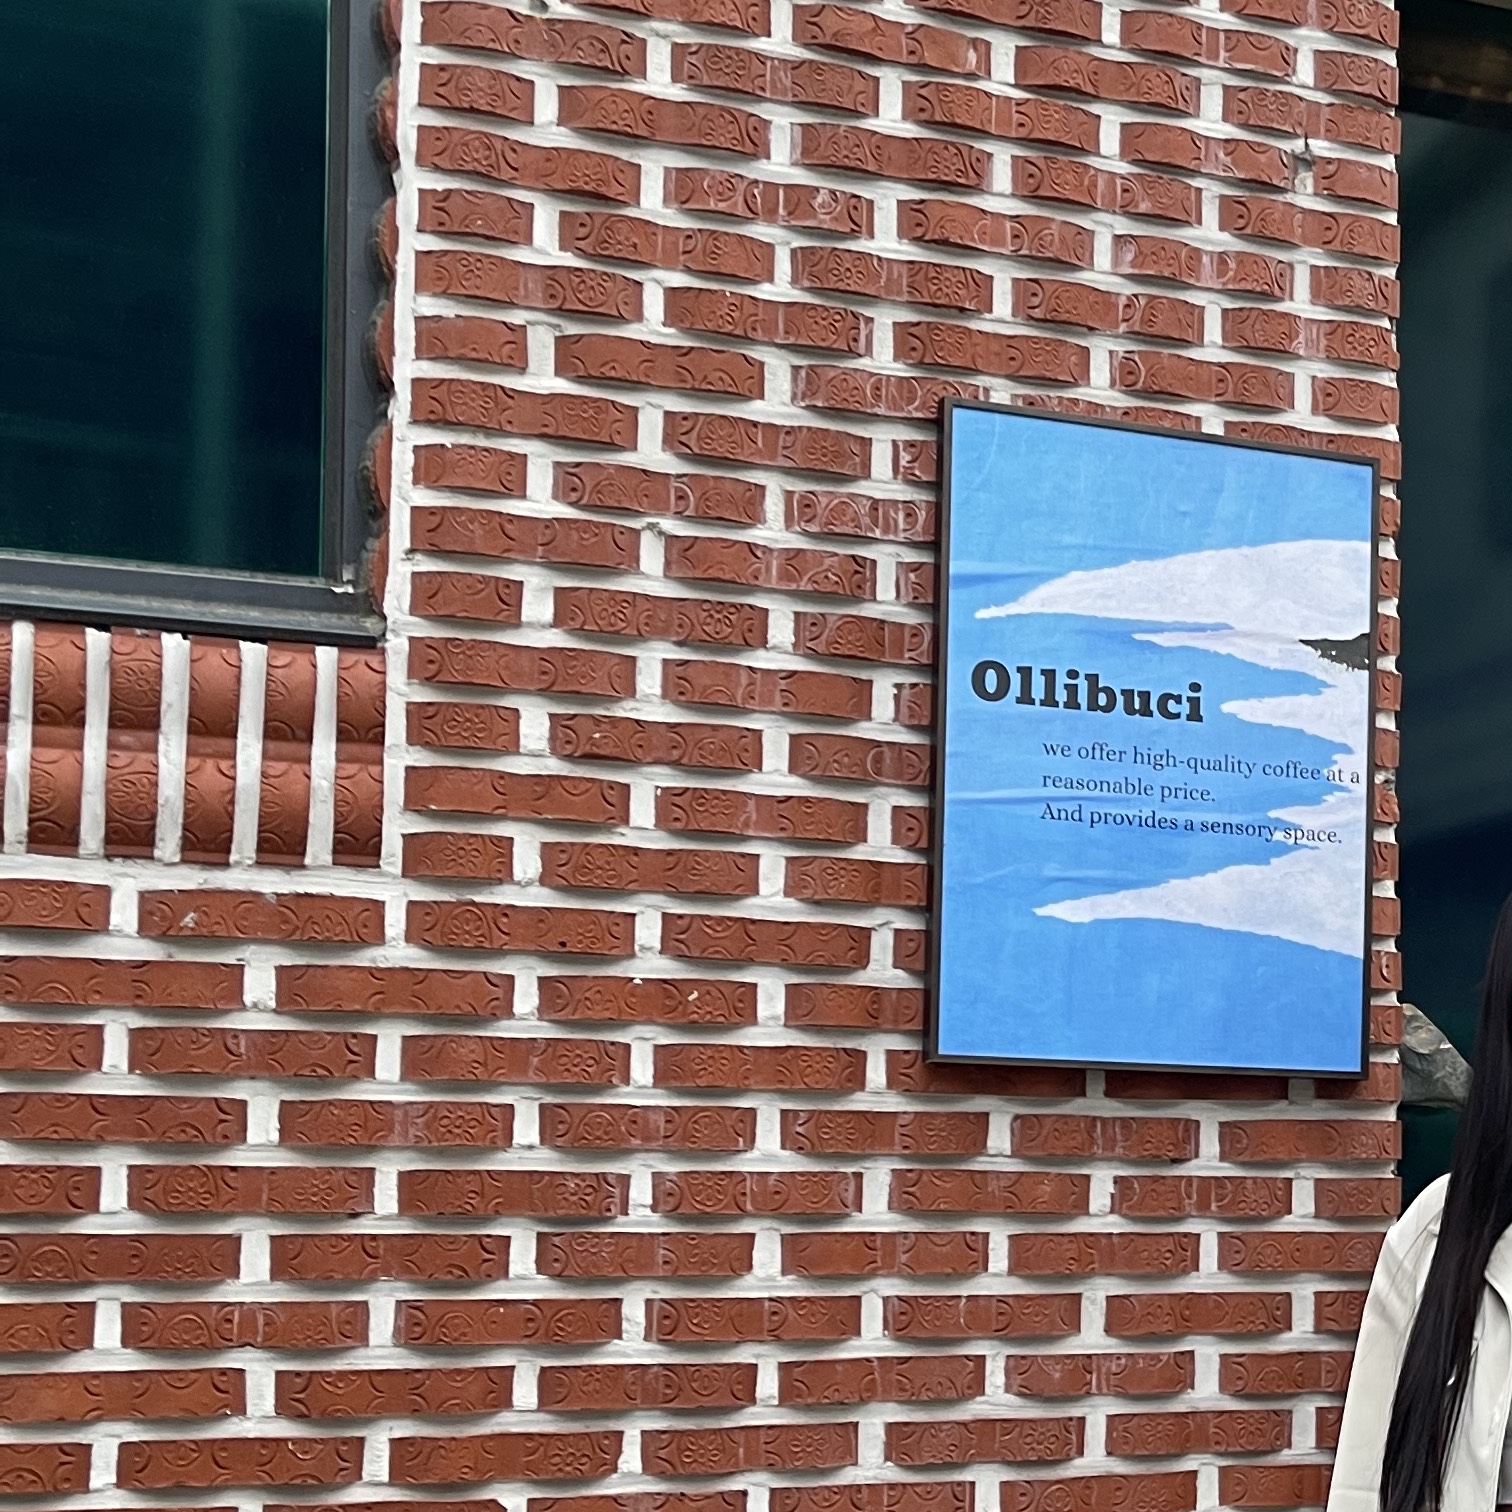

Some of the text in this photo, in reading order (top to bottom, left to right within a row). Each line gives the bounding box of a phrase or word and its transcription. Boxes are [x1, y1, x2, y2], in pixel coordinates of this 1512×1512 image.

[971, 660, 1203, 723] Ollibuci
[1043, 742, 1360, 785] we offer high-quality coffee at a
[1042, 774, 1216, 804] reasonable price.
[1040, 802, 1343, 845] And provides a sensory space.
